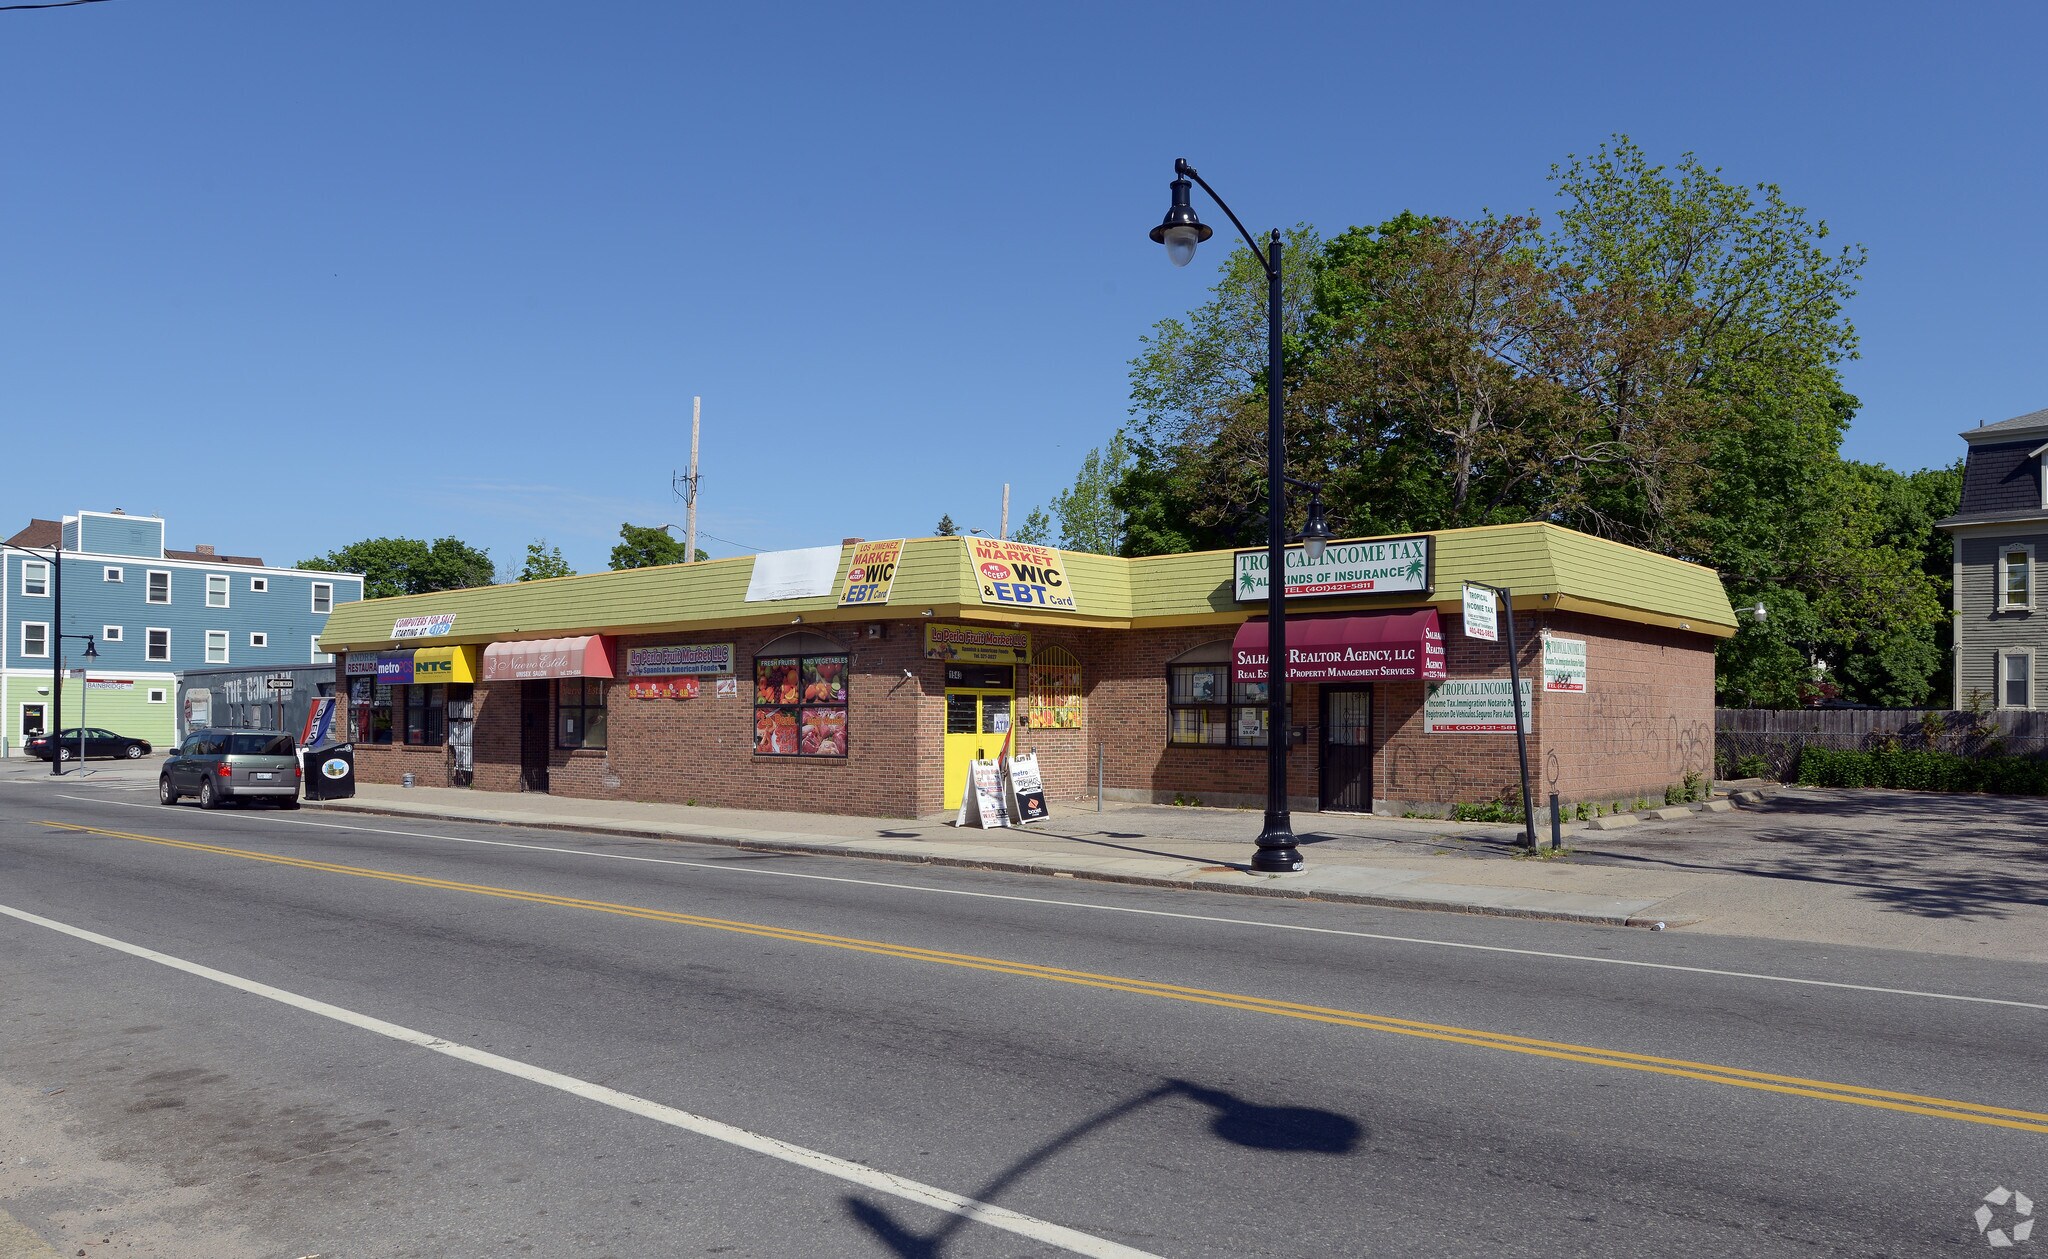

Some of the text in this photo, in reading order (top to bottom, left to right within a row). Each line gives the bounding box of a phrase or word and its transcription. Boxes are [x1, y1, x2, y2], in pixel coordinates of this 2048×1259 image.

[860, 542, 898, 552] LOS JIMENEZ
[977, 539, 1048, 556] LOS JIMENEZ
[853, 551, 899, 565] MARKET
[976, 547, 1053, 567] MARKET
[1240, 541, 1424, 571] TROCAL INCOME TAX
[866, 563, 894, 583] WIC
[983, 569, 1008, 579] ACCEPT
[1011, 563, 1062, 587] WIC
[1256, 566, 1405, 587] AL INDS OF INSURANCE
[846, 584, 879, 602] EBT
[874, 589, 888, 599] Card
[984, 582, 1073, 606] & EBT Card
[1306, 582, 1371, 593] (401)421-5811
[1469, 592, 1488, 602] TROPICAL
[396, 614, 455, 628] COMPUTERS FOR SALE
[395, 628, 418, 637] STARTING
[931, 627, 942, 642] La
[942, 628, 964, 643] Perla
[965, 630, 985, 645] Fruit
[985, 632, 1013, 647] Market
[631, 645, 729, 665] La Perla Fruit Market LLC
[1289, 650, 1341, 663] REALTOR
[1343, 647, 1392, 662] AGENCY,
[1395, 649, 1415, 660] LLC
[415, 661, 452, 673] NTC
[498, 655, 568, 670] Nuevo Estilo
[643, 666, 665, 674] Spanish
[672, 665, 699, 673] American
[700, 664, 717, 672] Foods
[1425, 657, 1443, 669] AGENCY
[1238, 670, 1256, 679] REAL
[1290, 668, 1326, 678] PROPERTY
[1327, 667, 1379, 677] MANAGEMENT
[1380, 666, 1415, 676] SERVICES
[224, 679, 242, 704] THE
[1441, 682, 1531, 696] TROPICAL INCOME AX
[1429, 700, 1446, 708] Income
[1487, 699, 1506, 707] Notario
[1426, 710, 1450, 720] Registracion
[1450, 710, 1456, 718] De
[1493, 710, 1503, 718] Para
[1503, 710, 1513, 718] Auto
[309, 708, 323, 740] OPEN
[996, 721, 1009, 730] ATM
